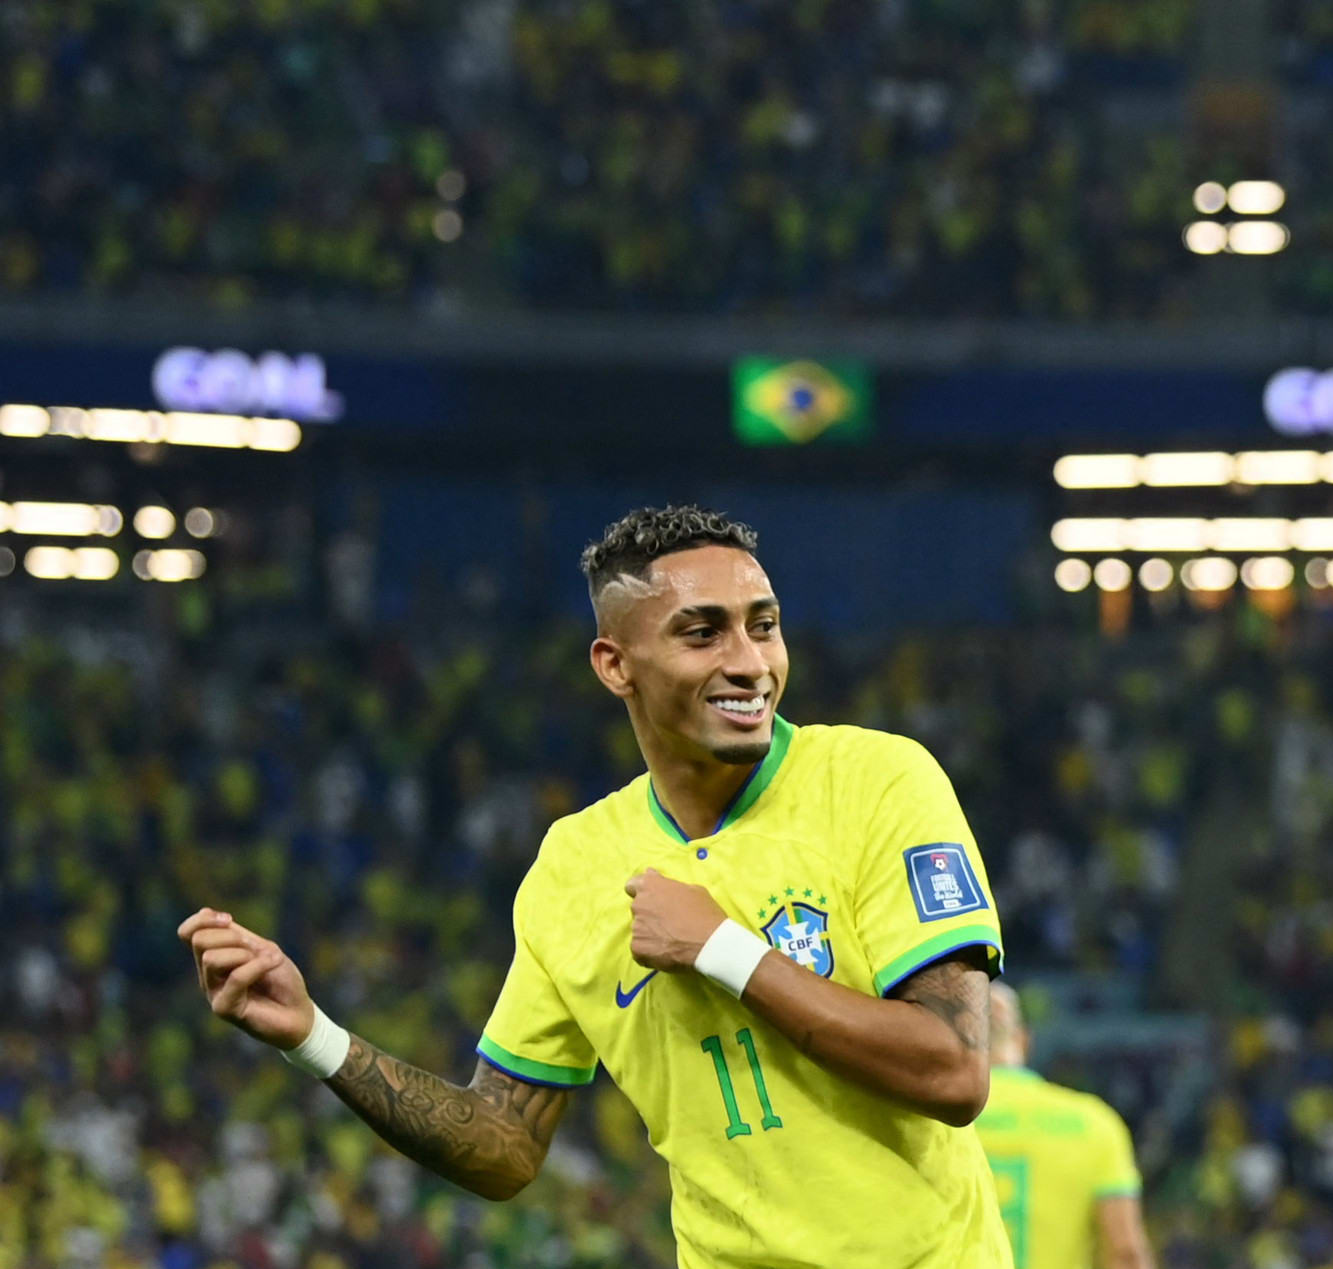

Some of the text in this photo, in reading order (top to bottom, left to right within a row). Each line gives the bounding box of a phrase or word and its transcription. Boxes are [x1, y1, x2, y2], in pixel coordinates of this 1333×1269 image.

[153, 346, 343, 422] GOAL
[788, 936, 813, 951] CBF
[701, 1027, 783, 1140] 11
